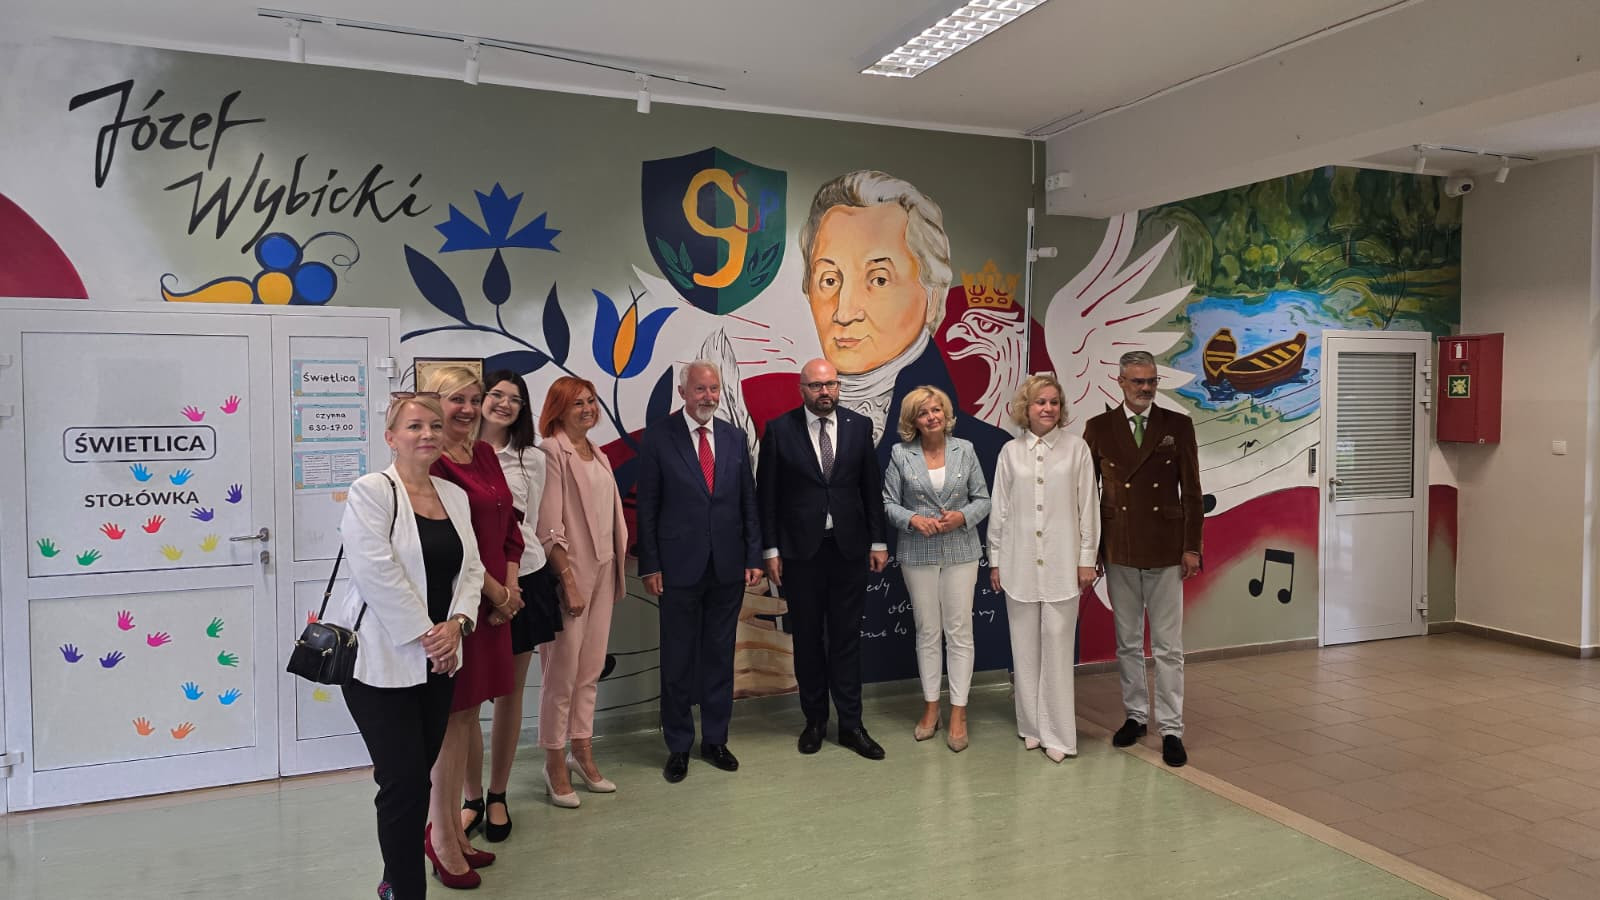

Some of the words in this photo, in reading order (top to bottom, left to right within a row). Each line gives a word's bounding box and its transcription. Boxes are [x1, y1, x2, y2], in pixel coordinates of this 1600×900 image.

[69, 79, 266, 188] Józef
[163, 152, 432, 253] Wybicki
[315, 413, 346, 421] czynna
[74, 433, 206, 453] ŚWIETLICA
[85, 490, 199, 508] STOŁÓWKA
